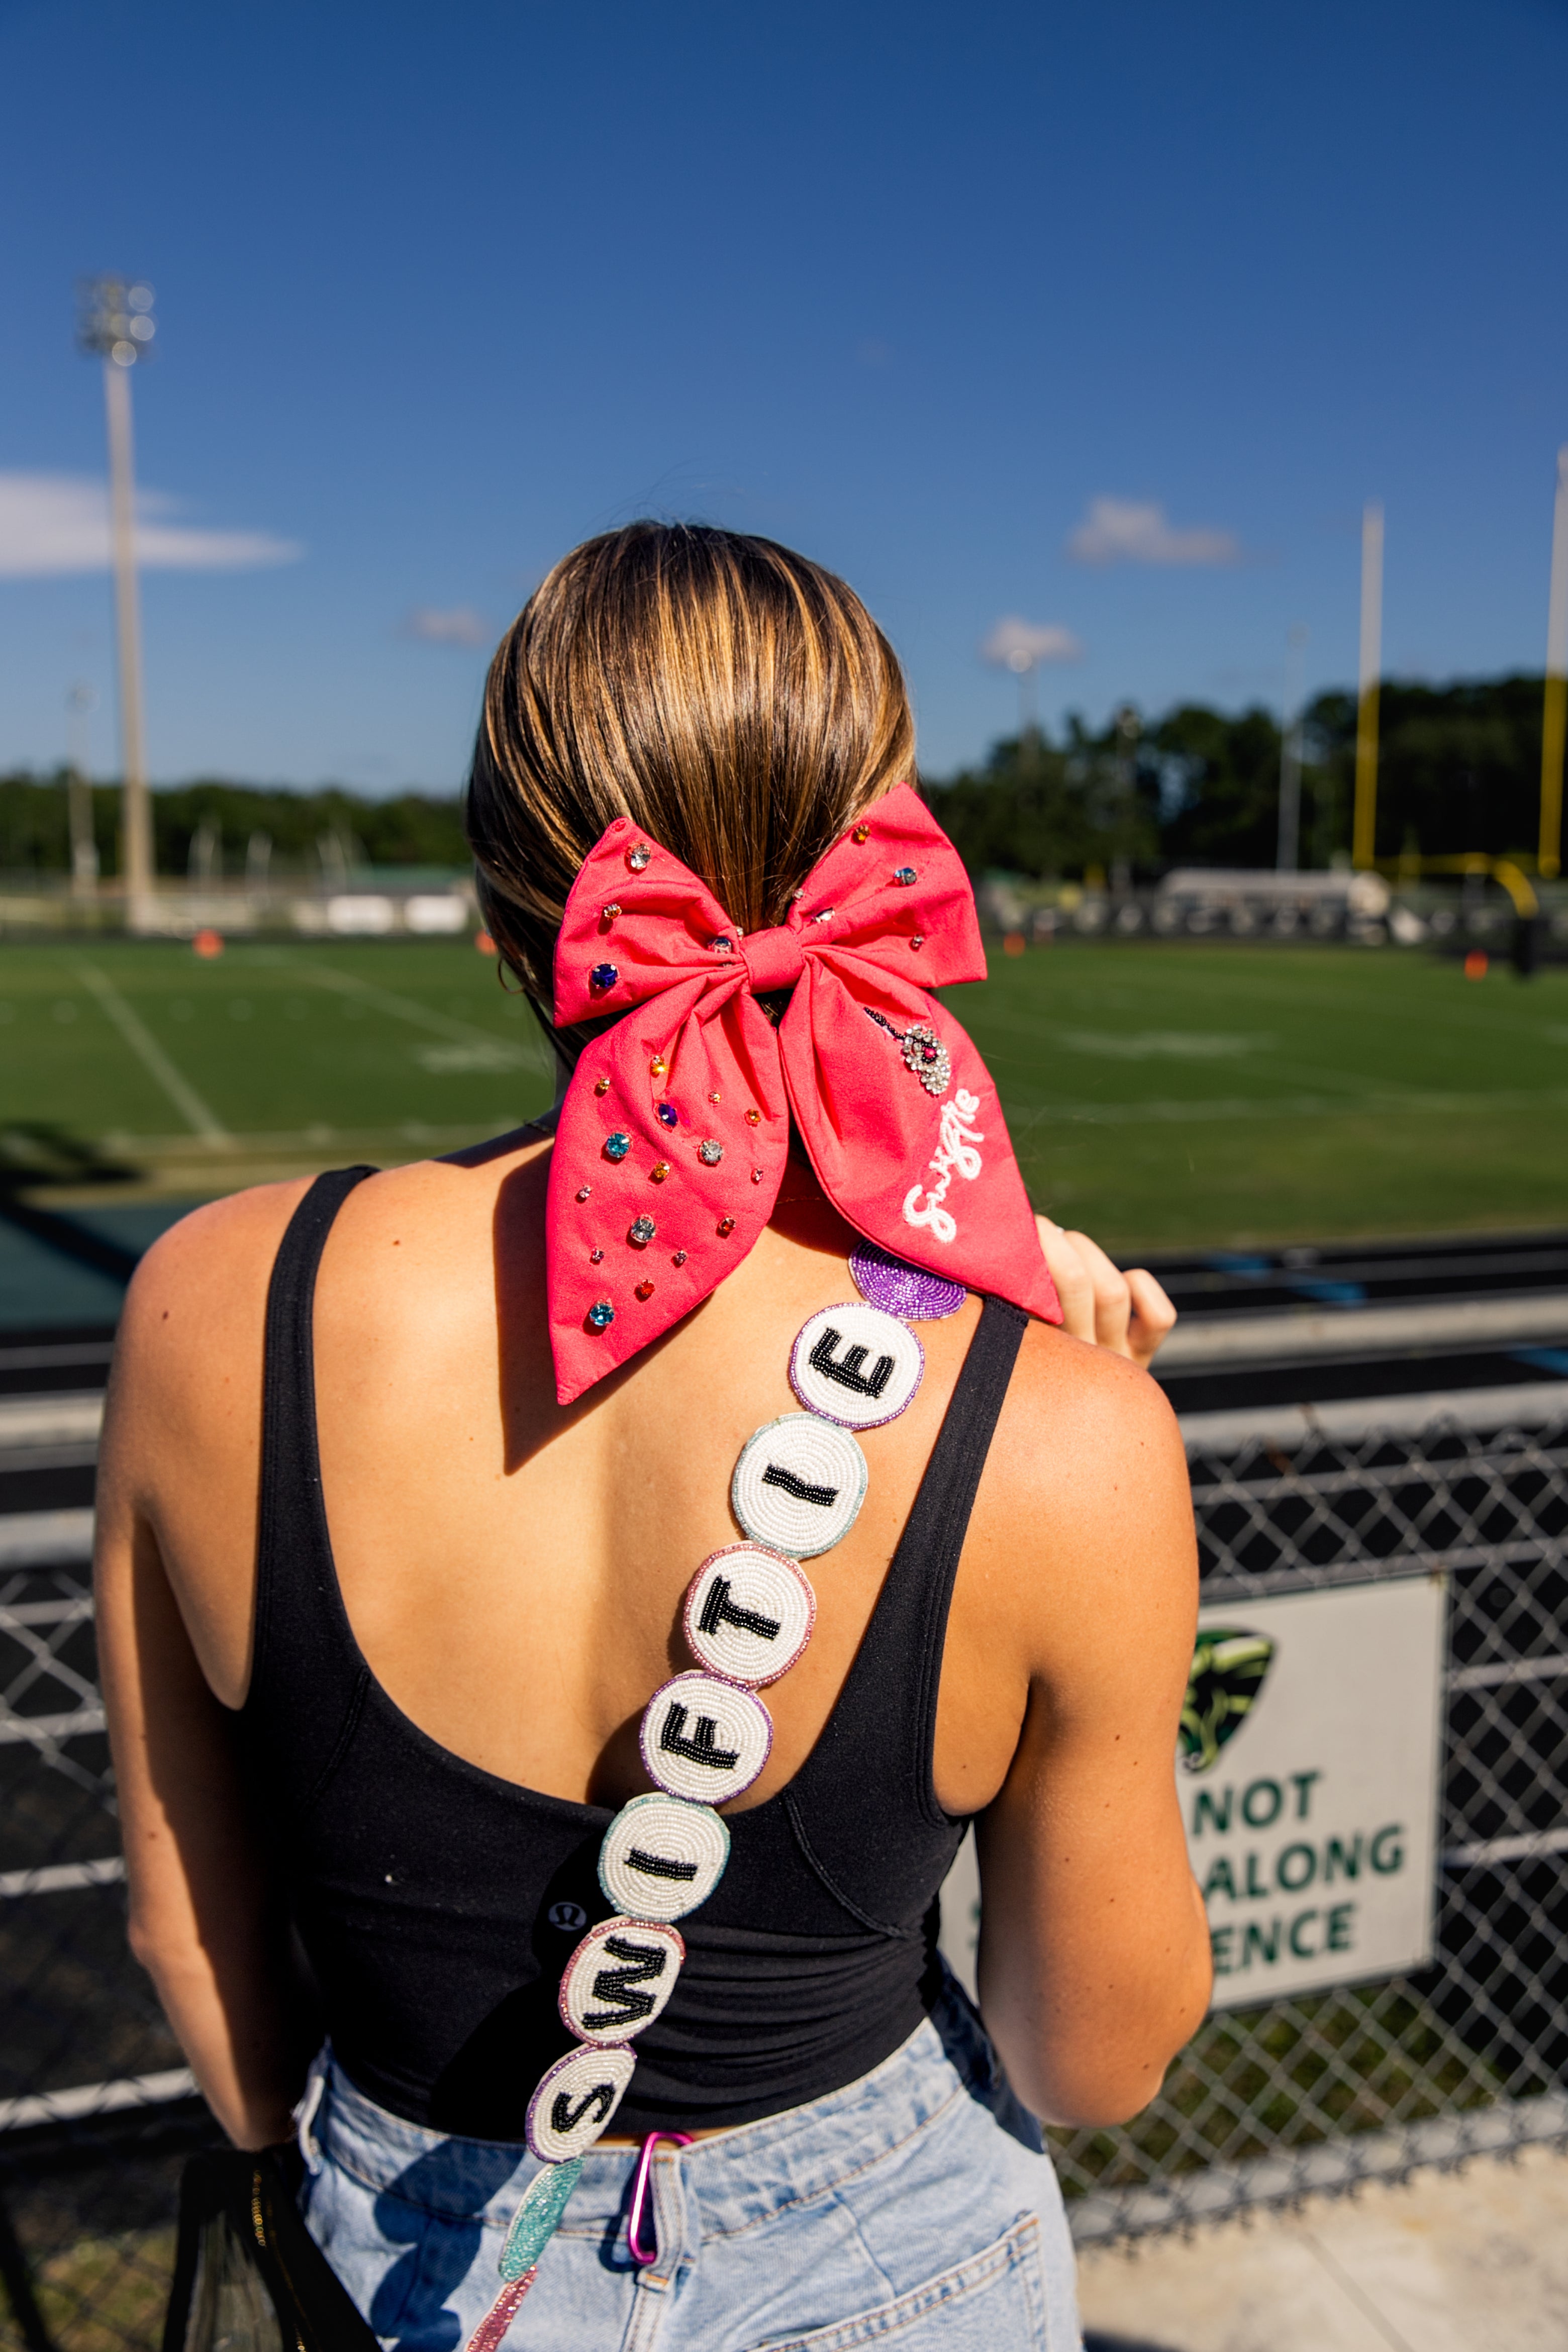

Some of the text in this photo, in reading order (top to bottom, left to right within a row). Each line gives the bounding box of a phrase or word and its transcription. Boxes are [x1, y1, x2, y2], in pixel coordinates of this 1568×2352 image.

[551, 1327, 895, 2133] SWIFTIE
[1193, 1771, 1322, 1838] NOT
[1203, 1823, 1404, 1902] ALONG
[1212, 1902, 1355, 1975] ENCE
